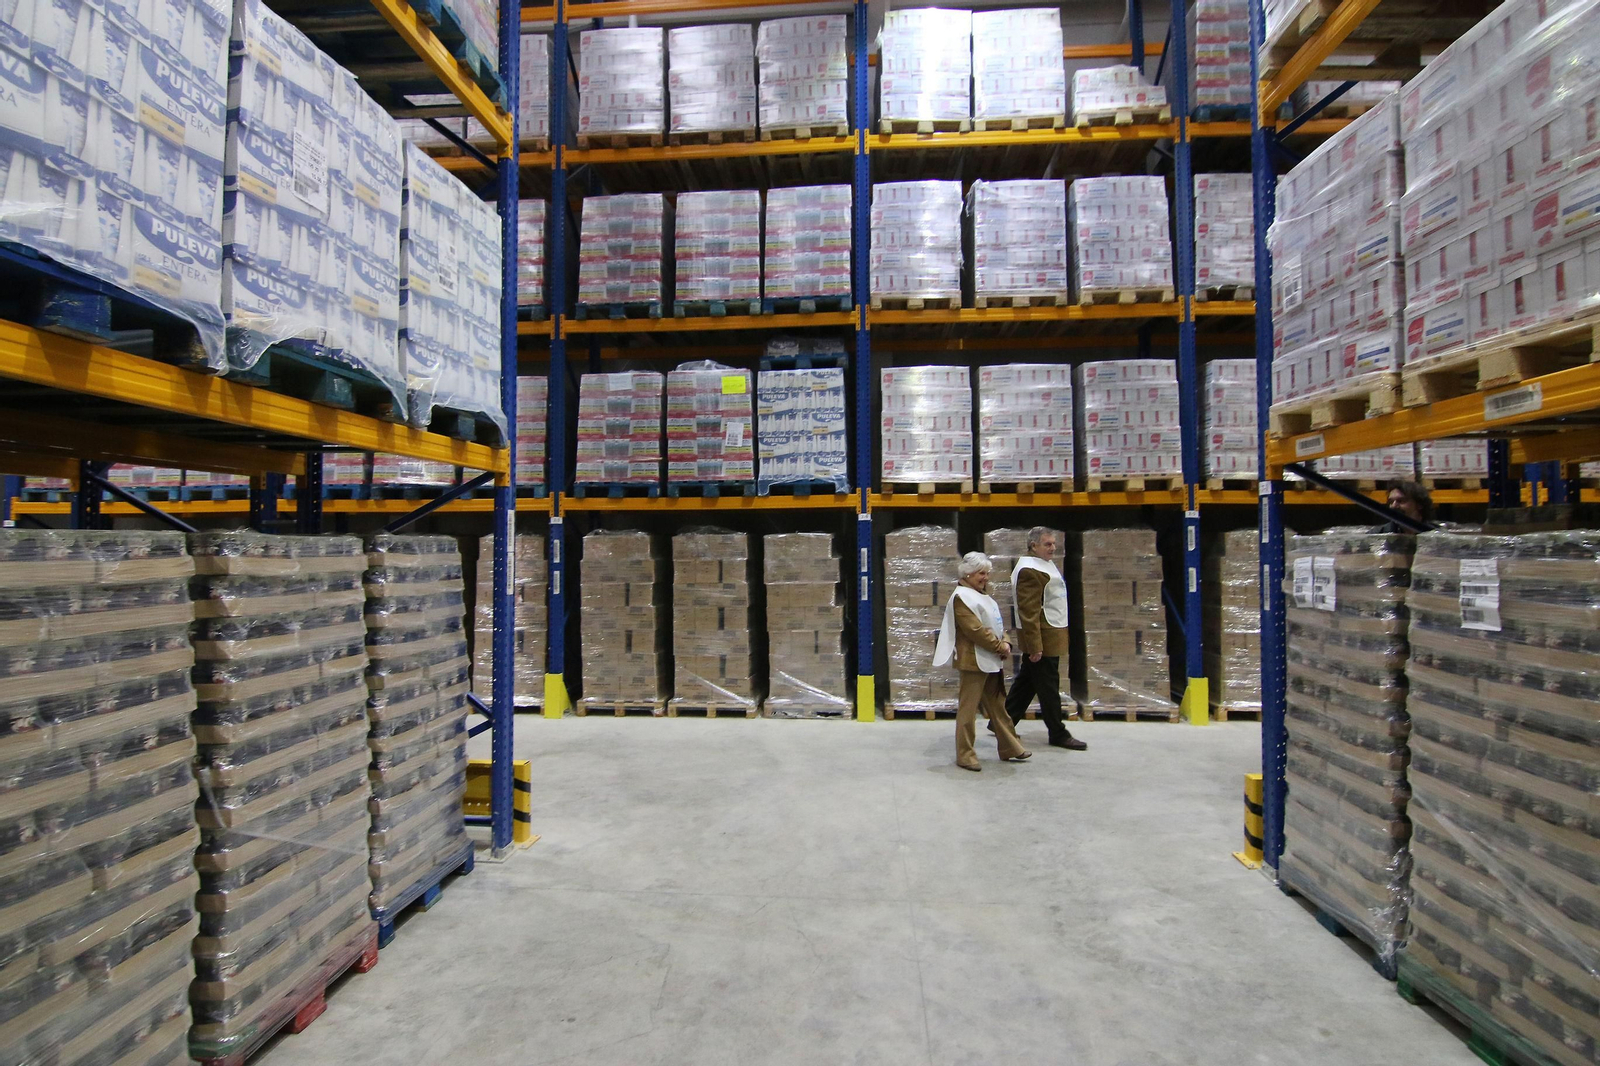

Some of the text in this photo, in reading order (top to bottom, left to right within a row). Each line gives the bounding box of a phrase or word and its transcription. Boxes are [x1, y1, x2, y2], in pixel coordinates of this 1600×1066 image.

[155, 59, 220, 120] PULEVA
[167, 99, 211, 138] ENTERA
[363, 150, 399, 186] PULEVA
[151, 217, 217, 263] PULEVA
[162, 254, 209, 282] ENTERA
[246, 269, 301, 303] PULEVA
[361, 262, 396, 291] PULEVA
